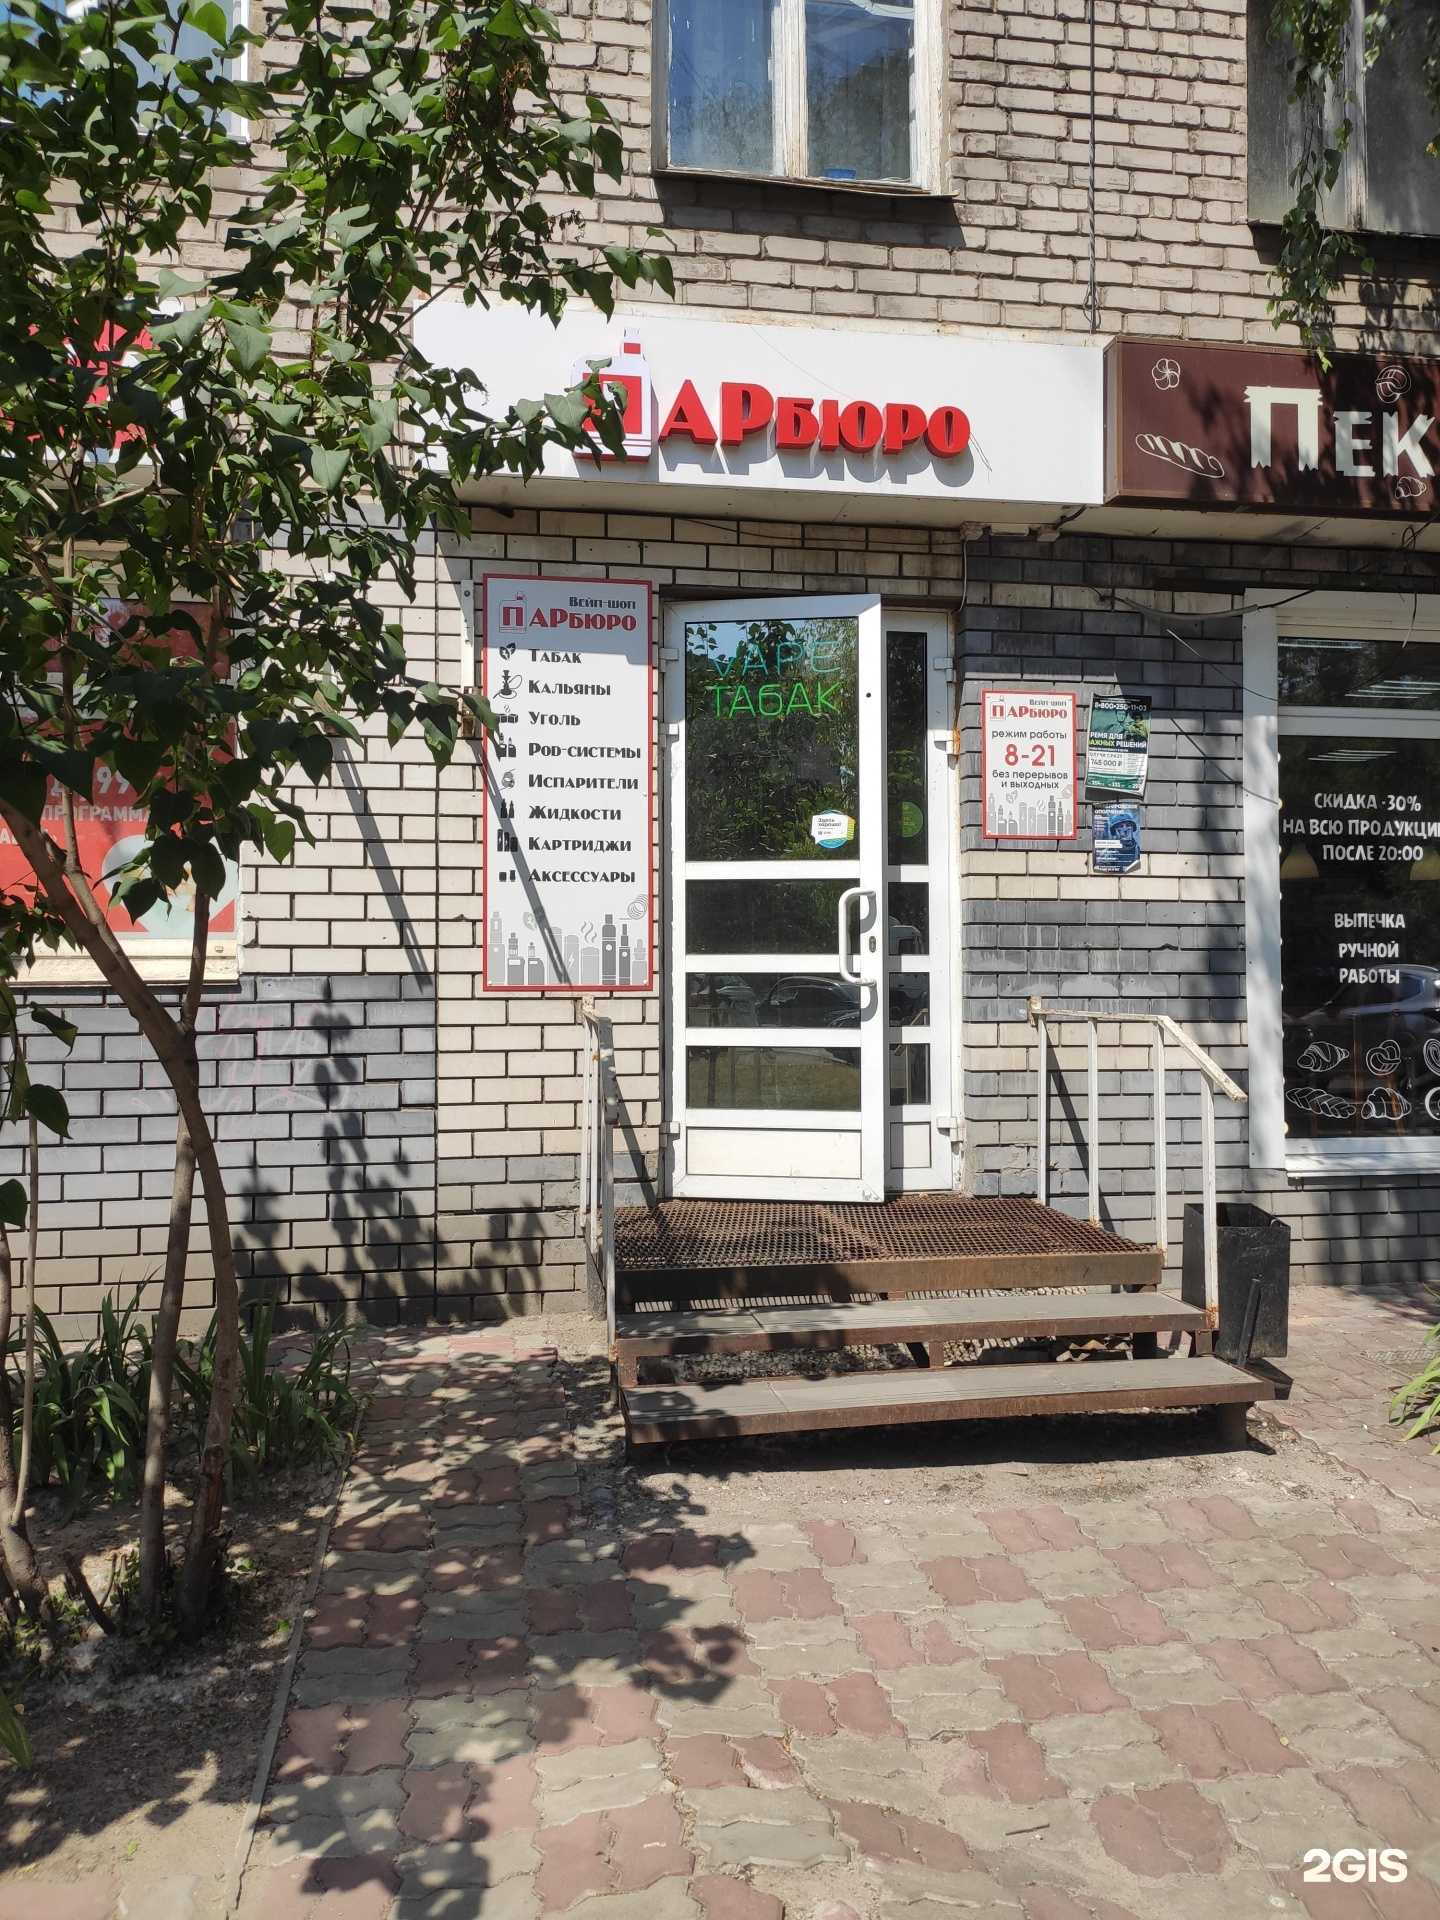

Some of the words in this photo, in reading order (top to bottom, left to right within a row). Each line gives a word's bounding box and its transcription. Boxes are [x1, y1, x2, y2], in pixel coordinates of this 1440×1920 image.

[714, 641, 842, 678] VAPE
[991, 730, 1027, 739] режим
[1029, 730, 1067, 739] работы
[1004, 744, 1055, 767] 8-21
[992, 769, 1010, 779] без
[1012, 771, 1068, 780] перерывов
[1010, 781, 1059, 789] выходных
[1314, 793, 1377, 809] СКИДКА
[1282, 819, 1306, 834] НА
[1309, 820, 1353, 835] ВСЮ
[1323, 845, 1364, 860] ПОСЛЕ
[1369, 846, 1423, 860] 20:00
[1334, 913, 1405, 928] ВЫПЕЧКА
[1338, 940, 1399, 958] РУЧНОЙ
[1340, 968, 1400, 984] РАБОТЫ
